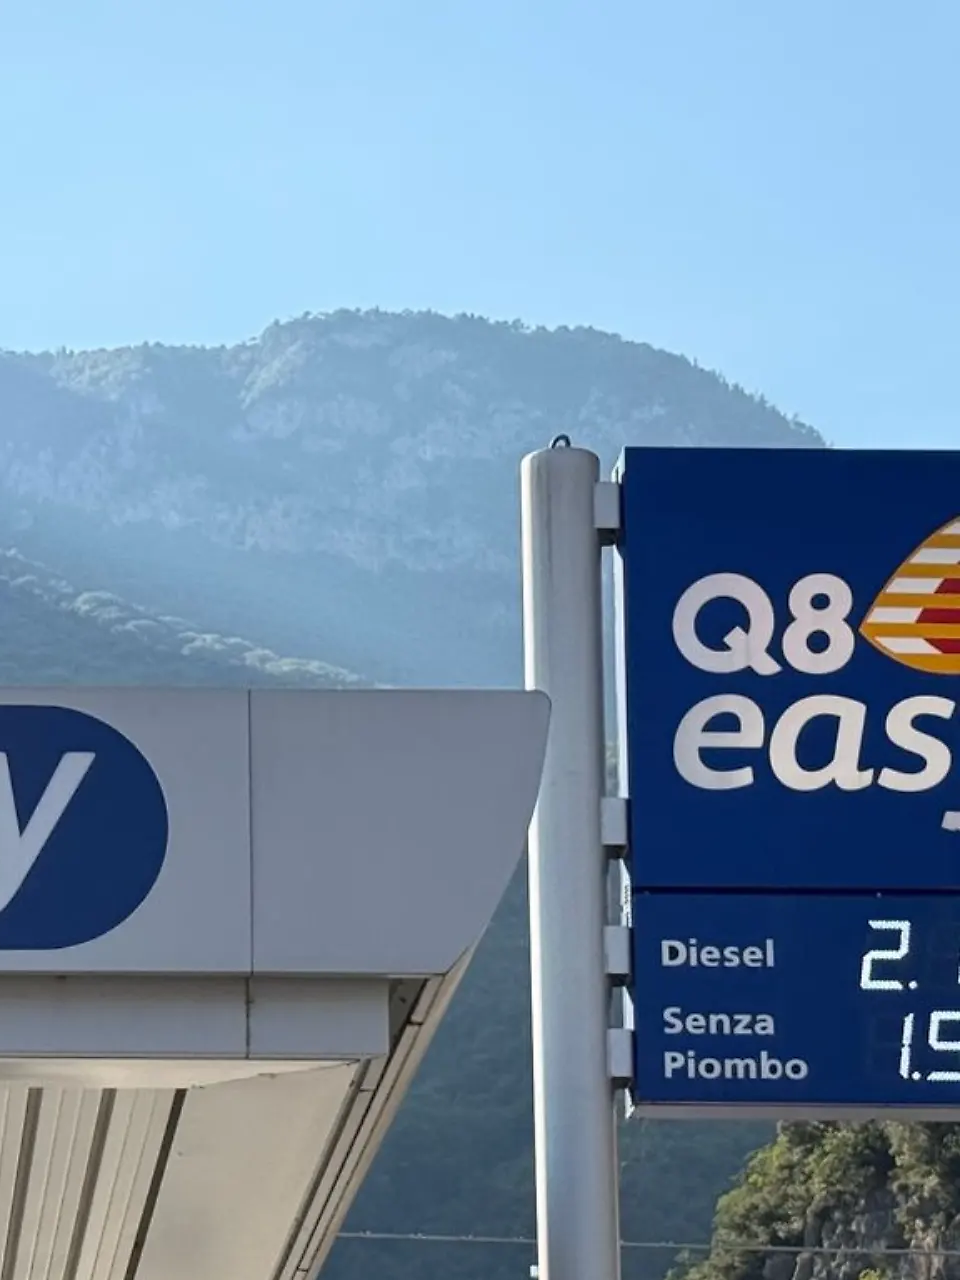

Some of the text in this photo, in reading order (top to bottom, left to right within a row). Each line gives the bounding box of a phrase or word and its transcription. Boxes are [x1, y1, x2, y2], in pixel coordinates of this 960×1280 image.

[672, 573, 855, 675] Q8
[672, 693, 960, 831] eas
[660, 938, 776, 970] Diesel
[860, 919, 960, 990] 2.
[663, 1007, 776, 1037] Senza
[663, 1050, 810, 1081] Piombo
